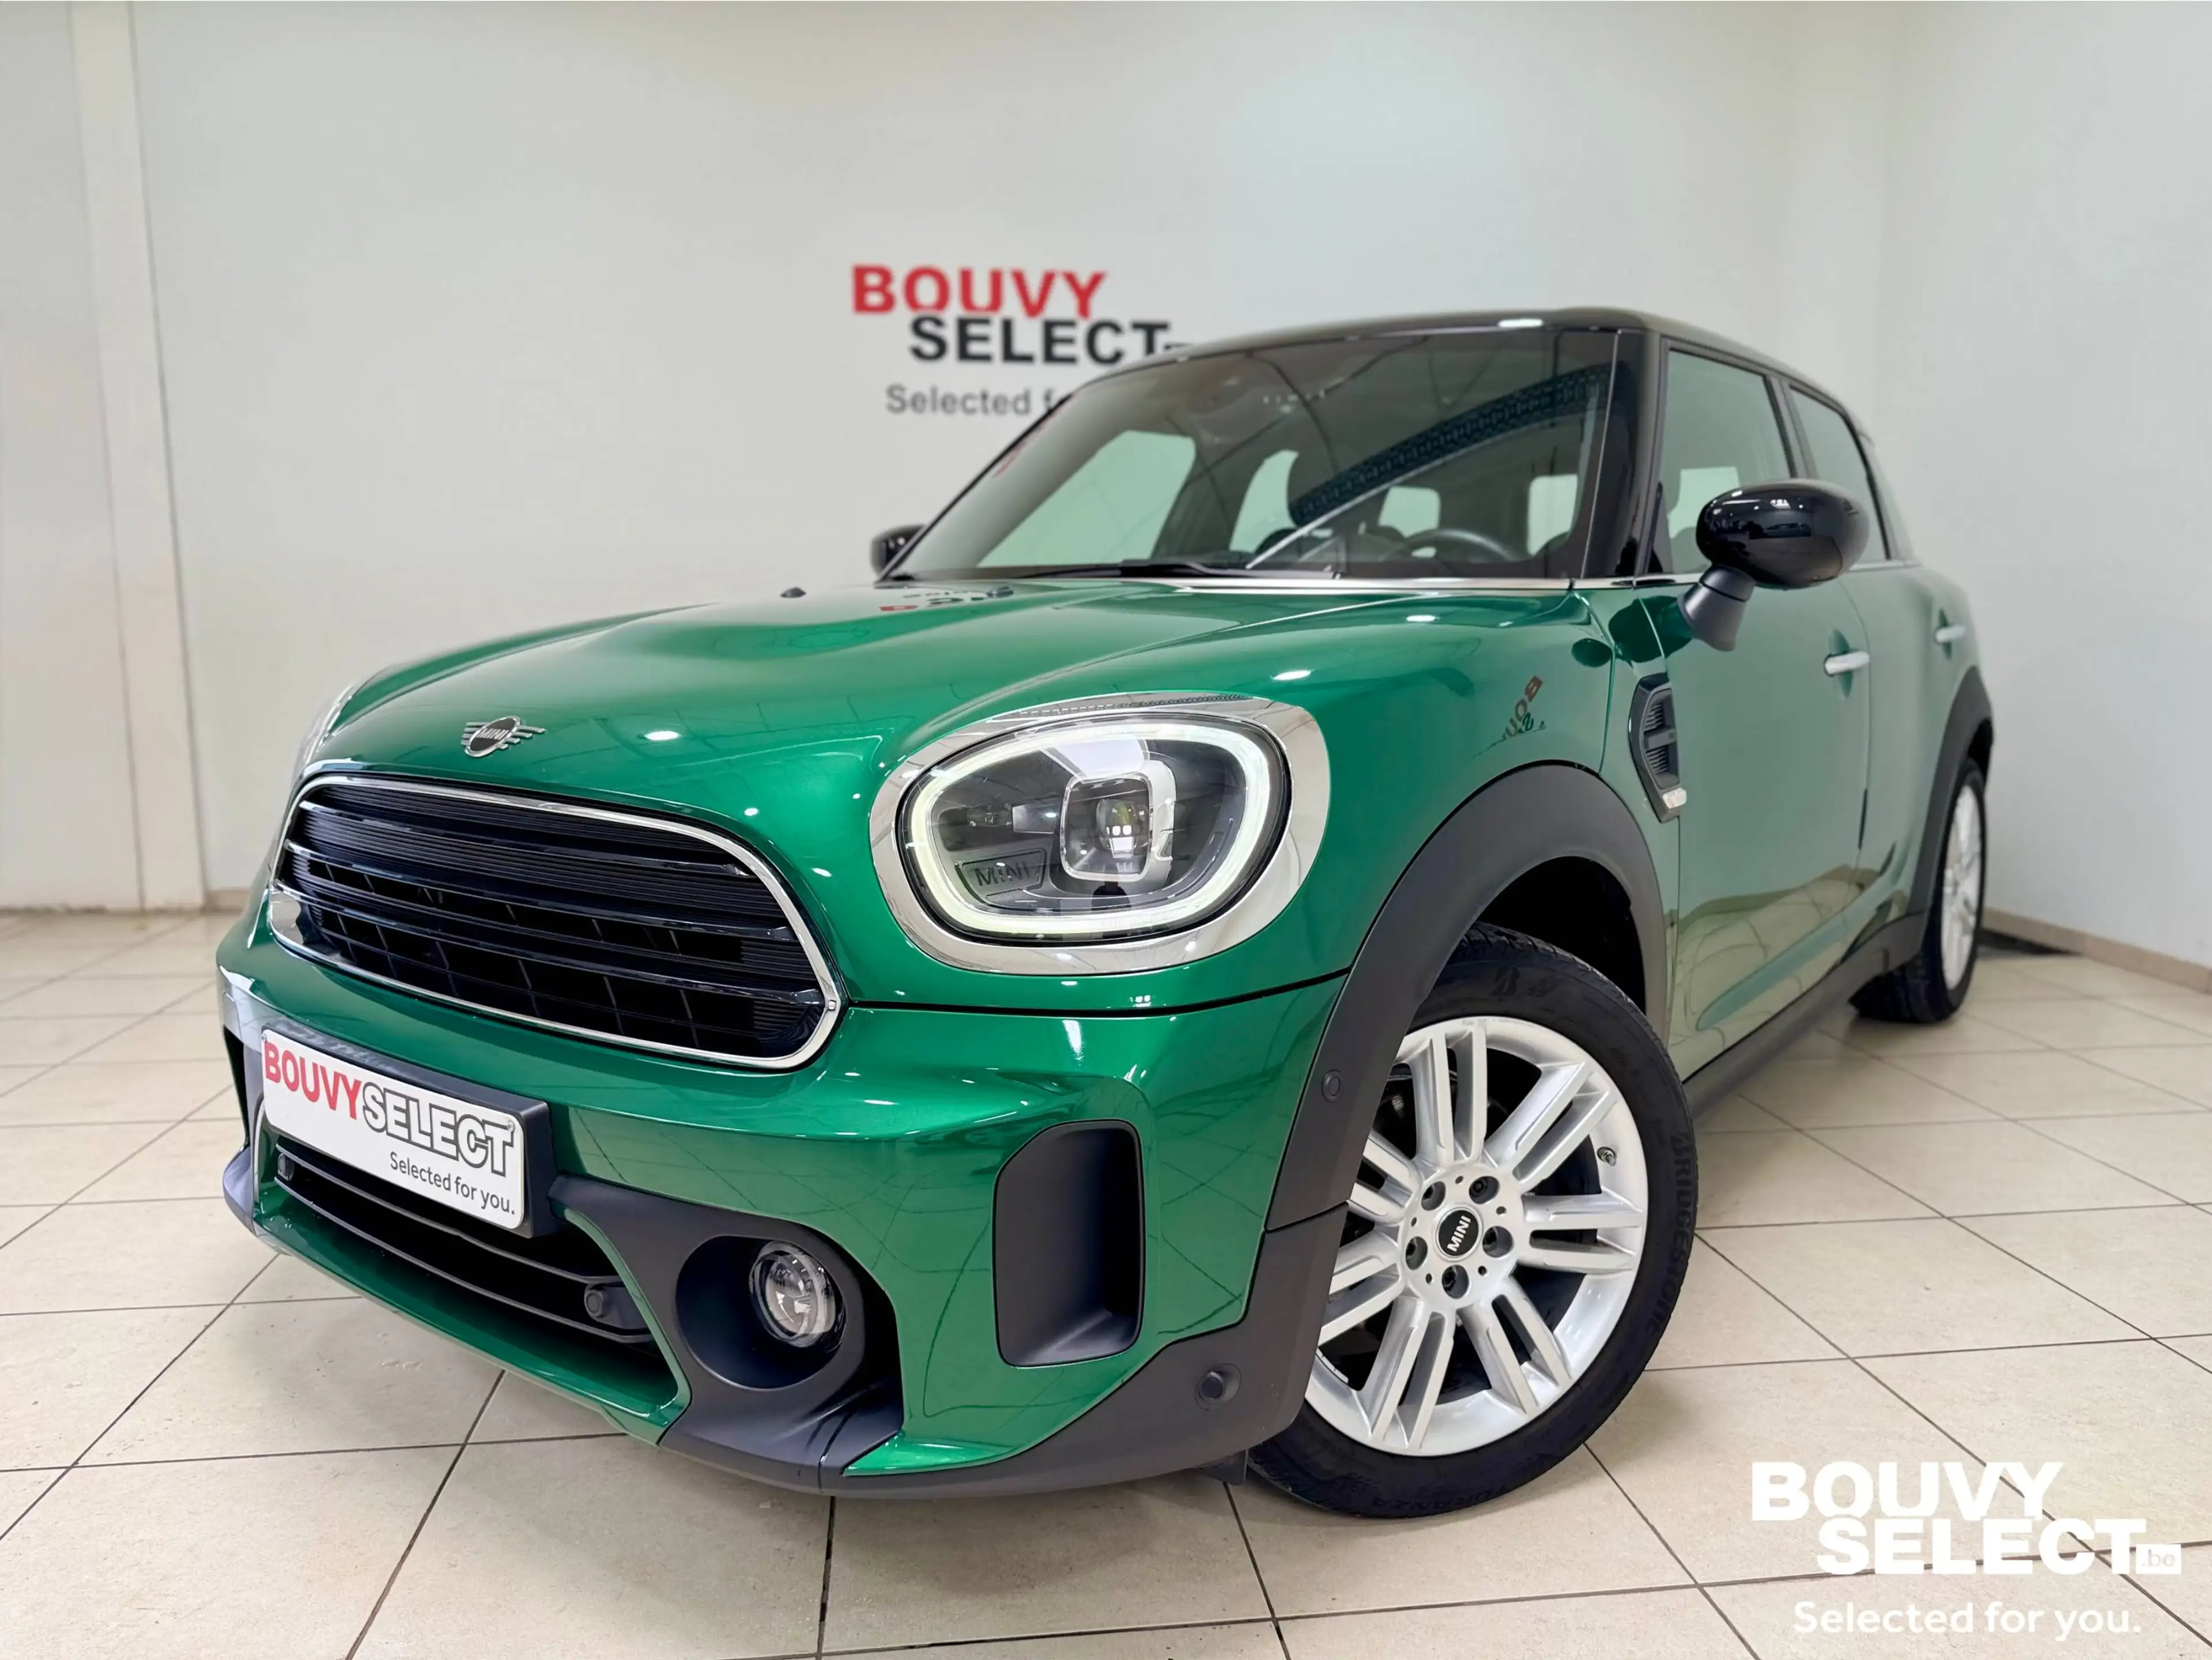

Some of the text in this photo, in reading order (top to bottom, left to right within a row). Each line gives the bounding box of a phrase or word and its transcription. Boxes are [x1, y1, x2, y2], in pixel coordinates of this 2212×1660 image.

[851, 264, 1107, 319] BOUVY
[909, 315, 1171, 365] SELECT
[885, 383, 1032, 416] Selected
[476, 728, 509, 740] MINI
[974, 861, 1030, 886] MINI
[389, 1151, 515, 1216] Selected for you.
[1447, 1214, 1471, 1252] MINI
[1645, 1132, 1695, 1337] BRIDGESTONE
